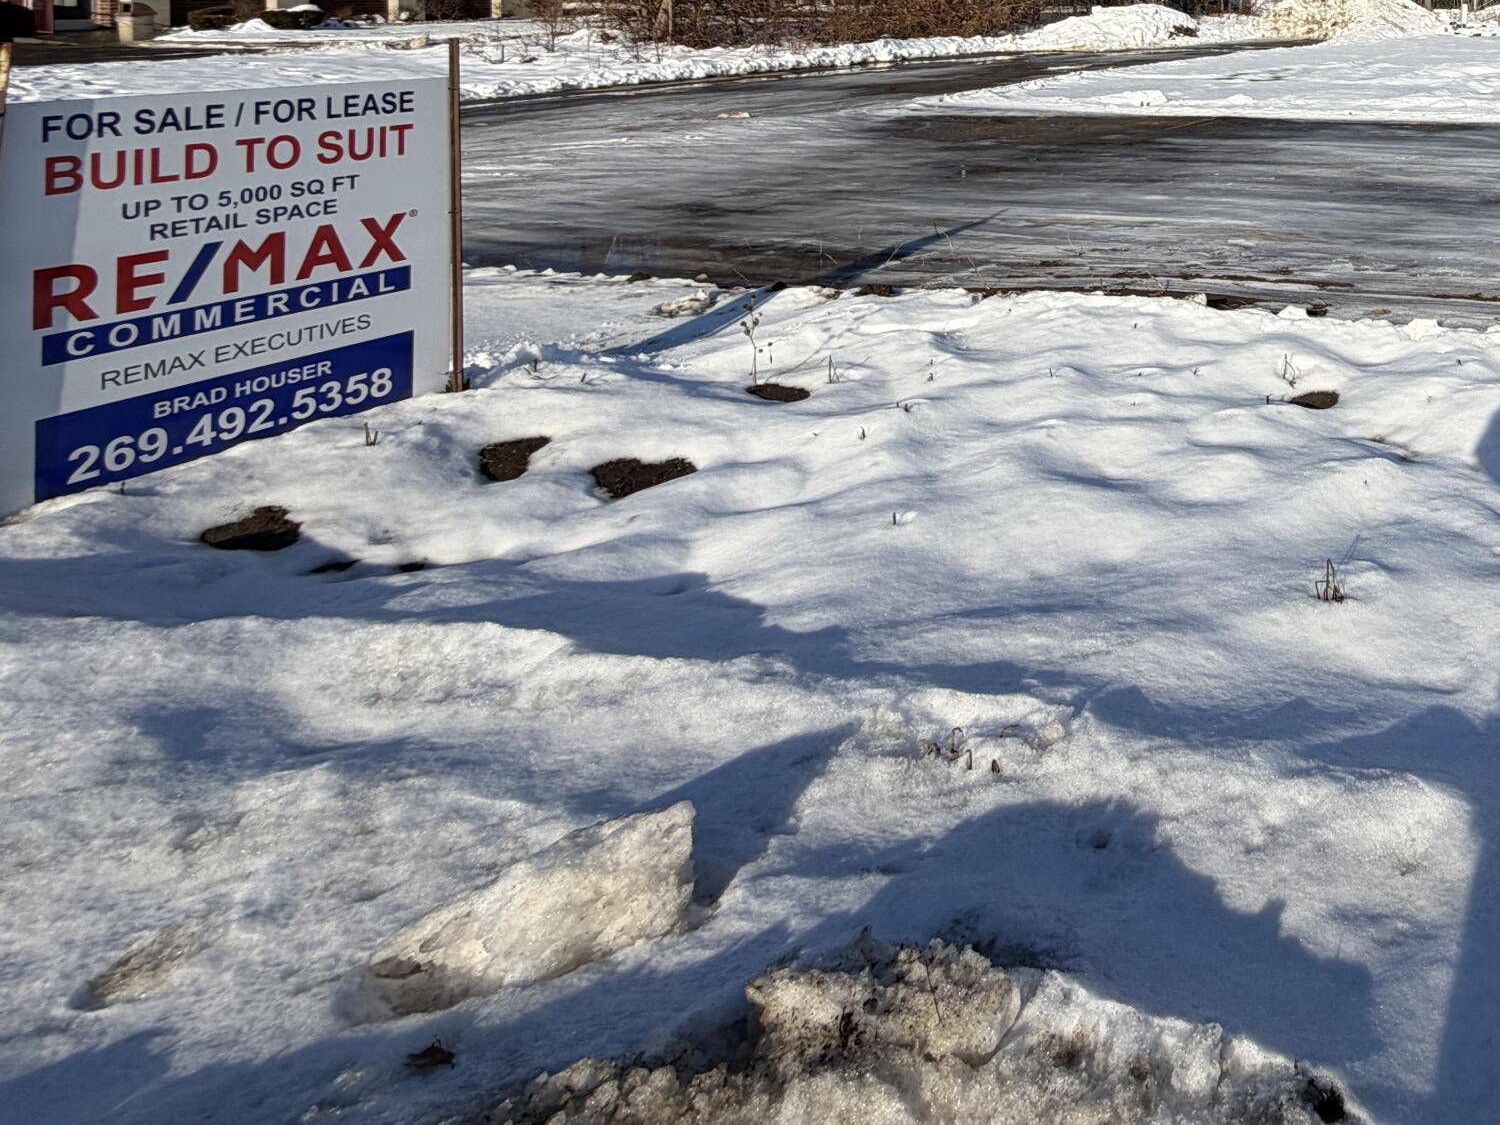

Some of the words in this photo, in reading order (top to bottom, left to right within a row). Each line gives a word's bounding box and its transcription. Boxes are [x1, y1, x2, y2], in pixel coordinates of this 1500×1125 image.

[42, 111, 123, 143] FOR
[133, 104, 226, 135] SALE
[254, 98, 317, 125] FOR
[326, 91, 415, 119] LEASE
[44, 142, 218, 196] BUILD
[235, 134, 301, 173] TO
[316, 123, 414, 164] SUIT
[122, 199, 162, 220] UP
[171, 193, 209, 213] TO
[217, 184, 282, 208] 5,000
[290, 179, 325, 198] SQ
[332, 174, 360, 193] FT
[150, 212, 248, 241] RETAIL
[255, 199, 338, 225] SPACE
[66, 273, 396, 356] COMMERCIAL
[101, 350, 206, 390] REMAX
[215, 313, 372, 363] EXECUTIVES
[153, 386, 227, 419] BRAD
[234, 360, 333, 398] HOUSER
[66, 367, 393, 485] 269.492.5358
